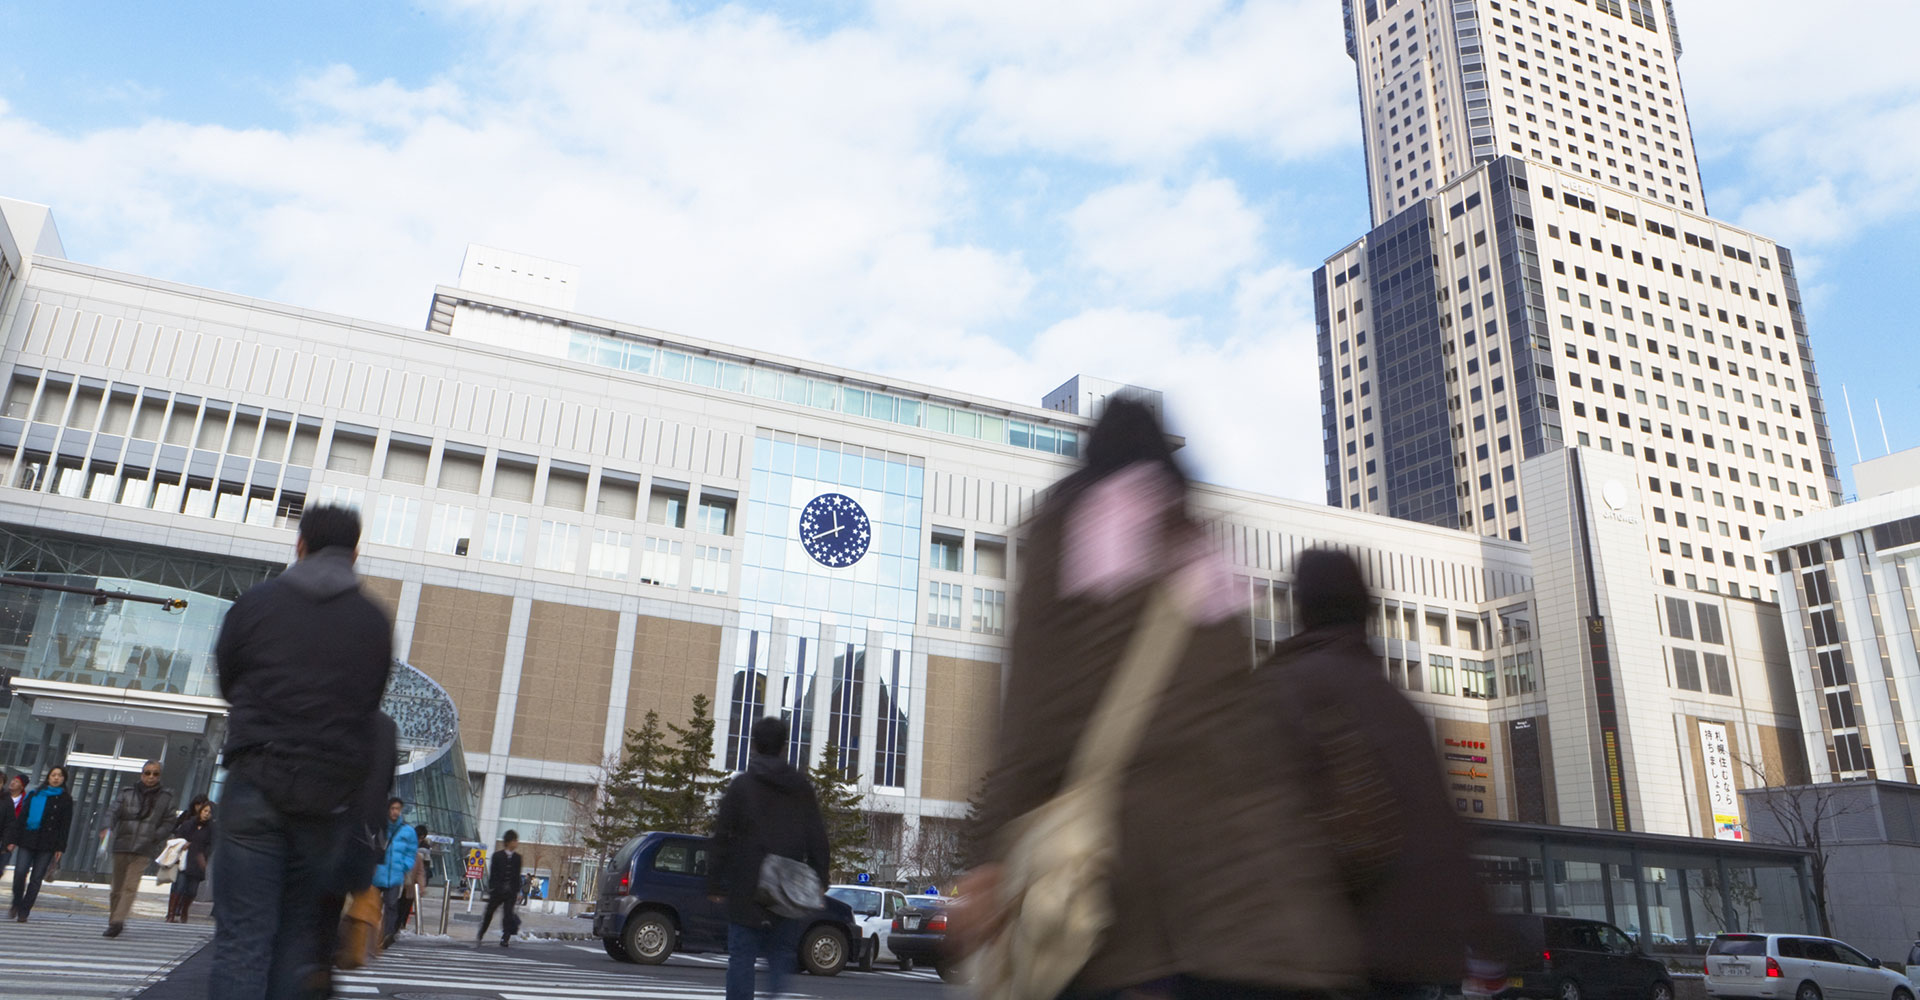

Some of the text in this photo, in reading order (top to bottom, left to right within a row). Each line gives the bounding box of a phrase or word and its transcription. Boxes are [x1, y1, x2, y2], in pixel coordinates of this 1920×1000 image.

[1704, 729, 1721, 802] 待ちましょう
[1715, 731, 1732, 805] 札幌住むなら
